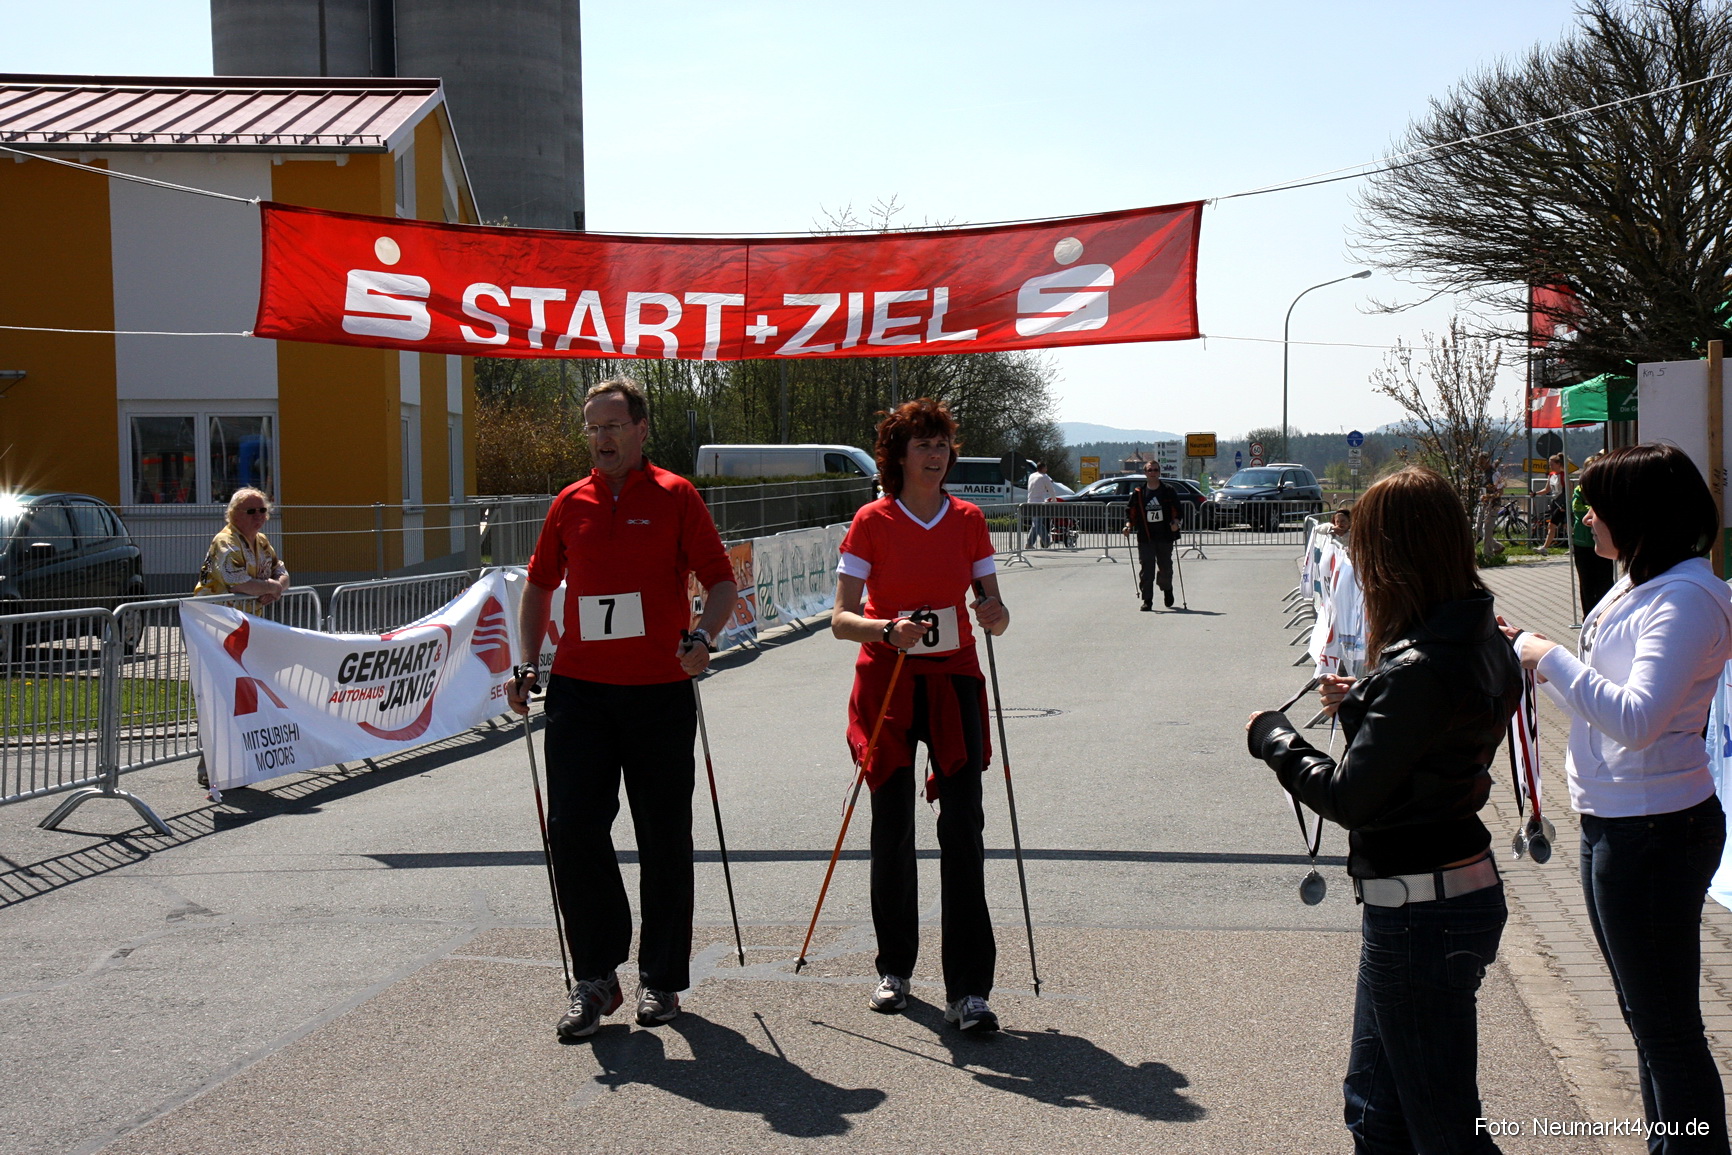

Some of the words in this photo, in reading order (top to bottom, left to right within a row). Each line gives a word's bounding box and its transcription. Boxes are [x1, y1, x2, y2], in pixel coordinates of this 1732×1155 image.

[1657, 367, 1667, 377] 5
[963, 485, 996, 493] MAIER
[1150, 511, 1160, 521] 74
[599, 598, 615, 635] 7
[922, 612, 939, 648] 8
[337, 639, 439, 685] GERHART
[433, 643, 443, 663] &
[328, 685, 385, 704] AUTOHAUS
[379, 669, 437, 712] JÄNIG
[242, 722, 300, 751] MITSUBISHI
[255, 745, 296, 772] MOTORS
